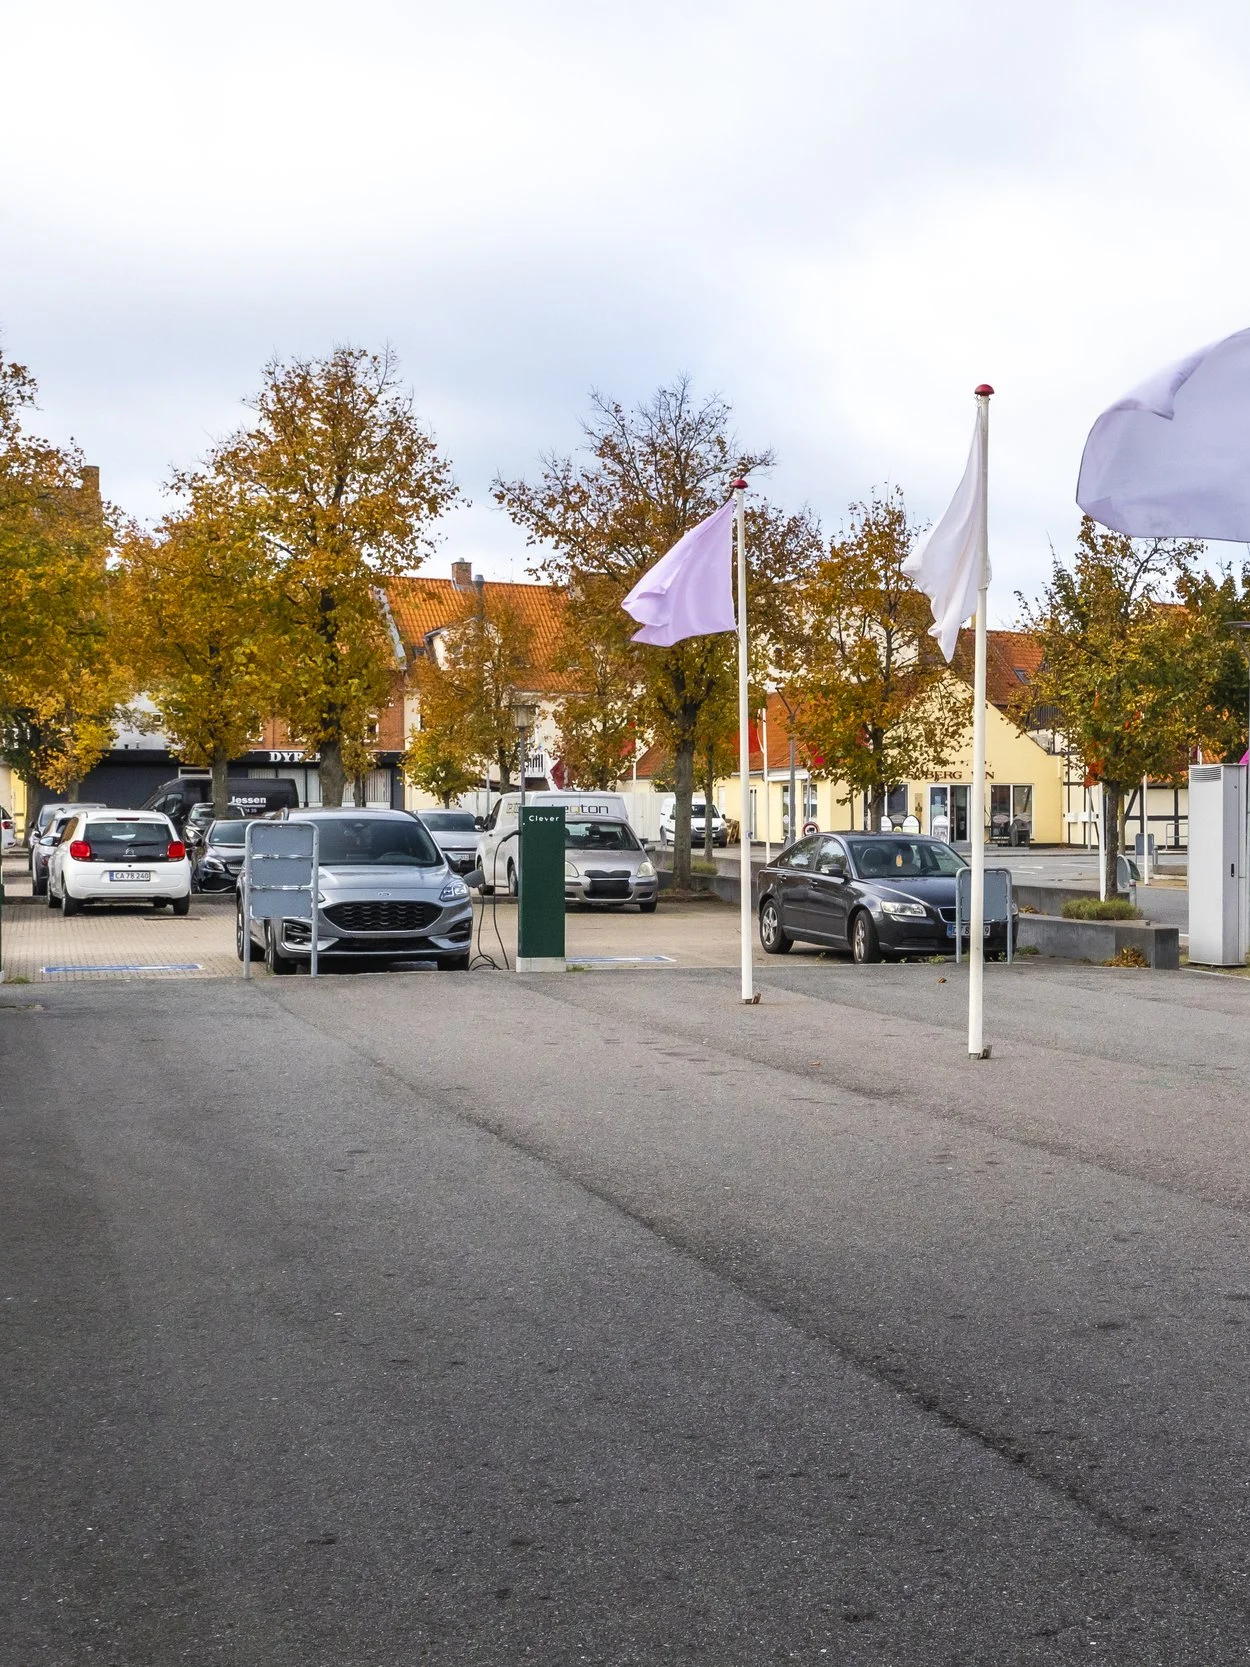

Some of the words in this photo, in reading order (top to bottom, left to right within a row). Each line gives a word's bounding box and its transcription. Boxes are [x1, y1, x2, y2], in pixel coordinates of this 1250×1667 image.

[231, 796, 267, 804] Jessen
[528, 815, 560, 823] Clever
[115, 872, 126, 880] CA
[126, 872, 135, 880] 78
[136, 872, 149, 880] 240
